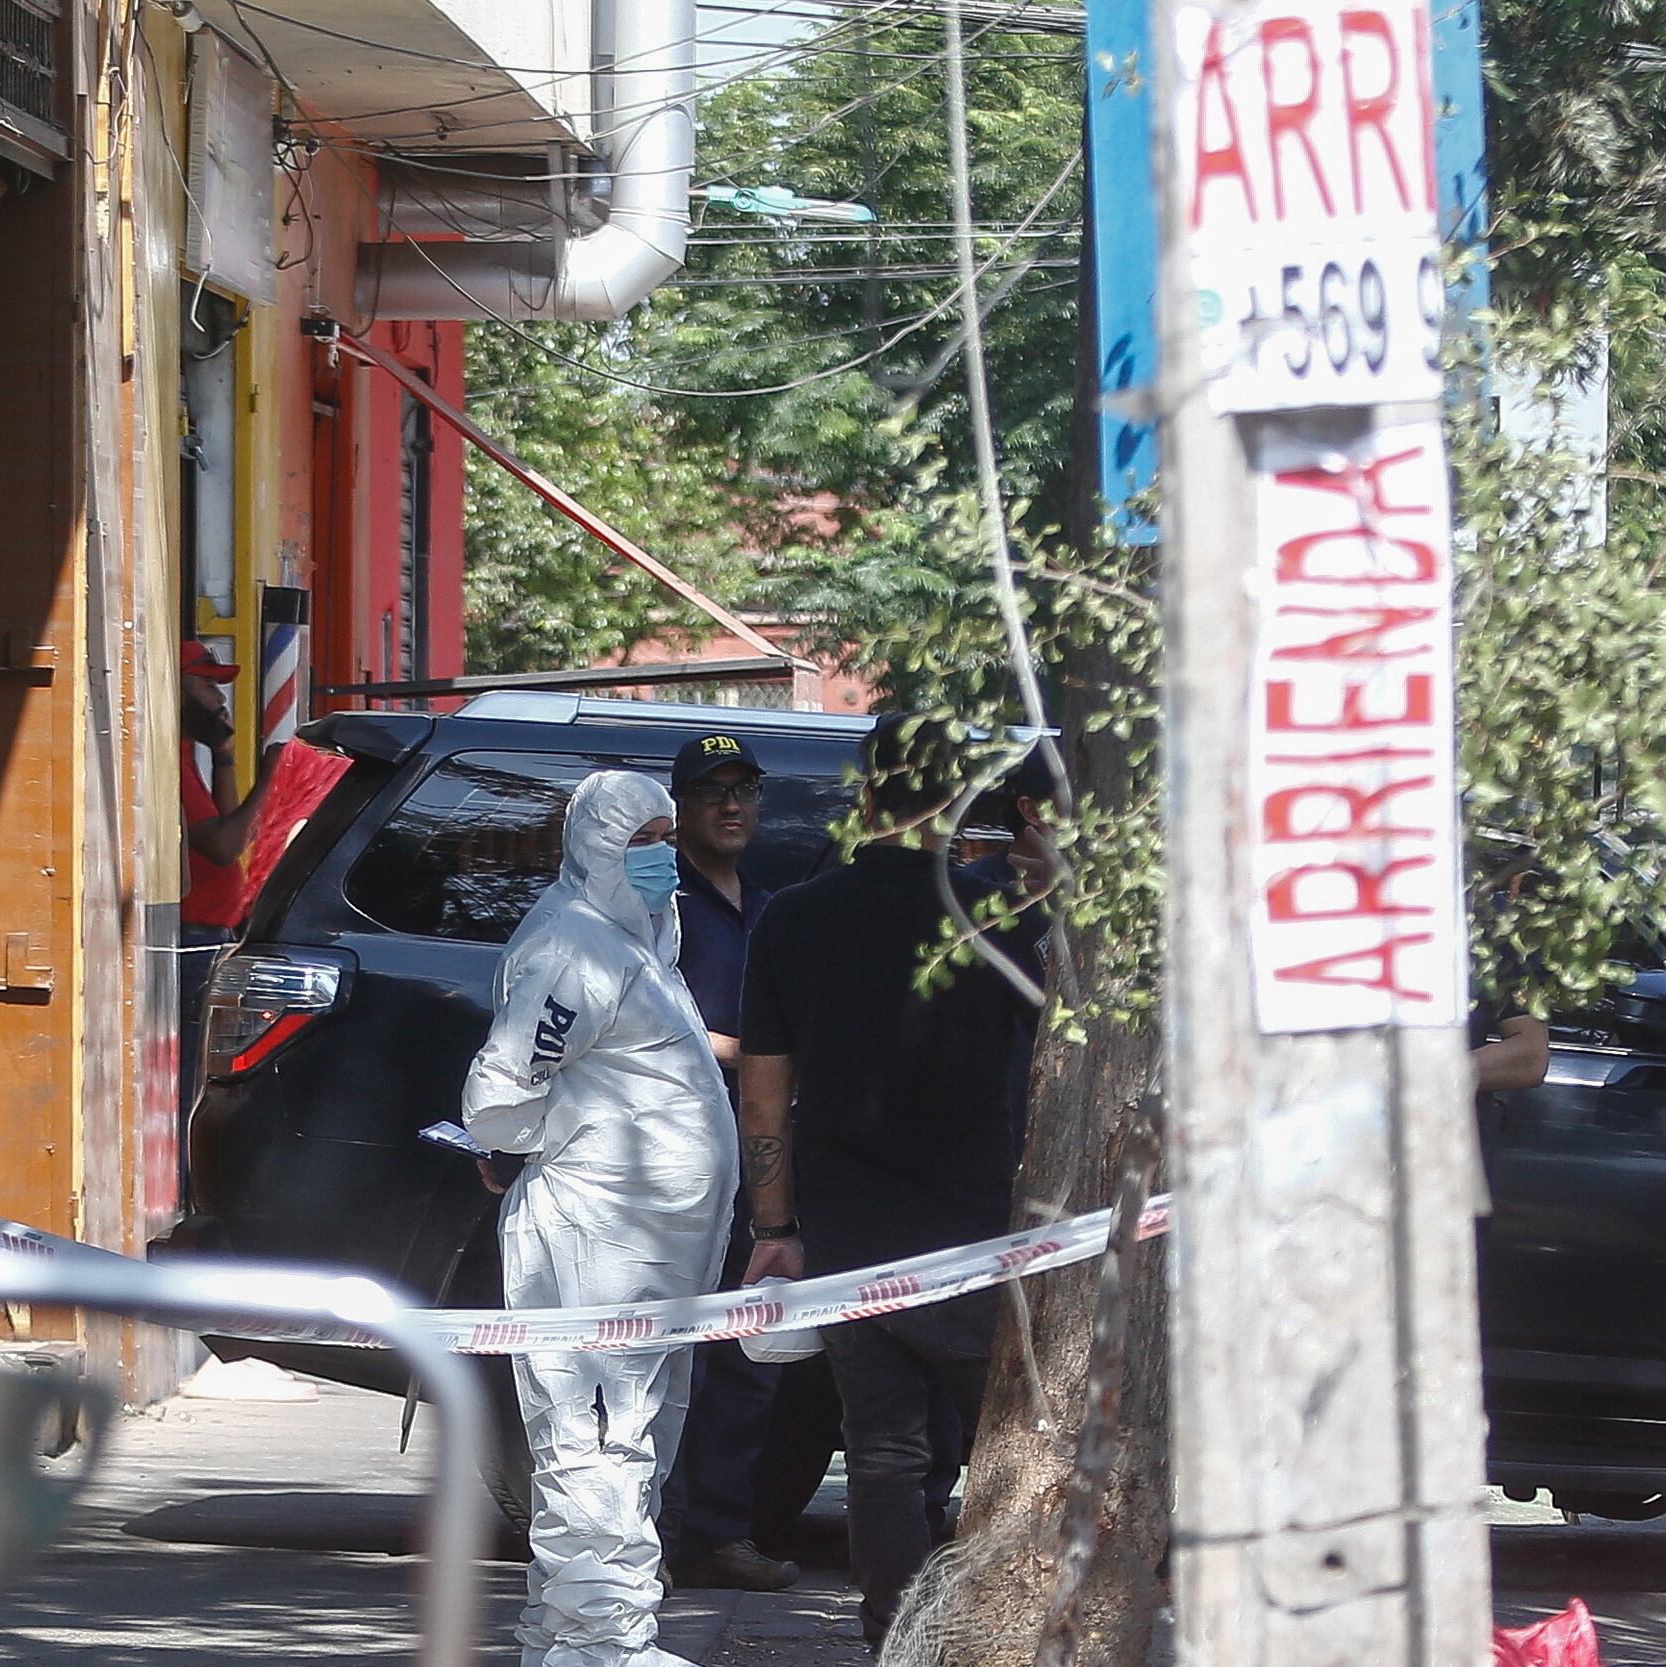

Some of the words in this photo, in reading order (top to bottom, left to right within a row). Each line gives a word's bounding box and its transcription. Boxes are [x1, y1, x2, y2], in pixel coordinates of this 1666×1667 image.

[1189, 8, 1437, 230] ARRI
[701, 736, 740, 752] PDI
[1263, 447, 1441, 1003] ARRIENDA
[530, 994, 578, 1066] PDI
